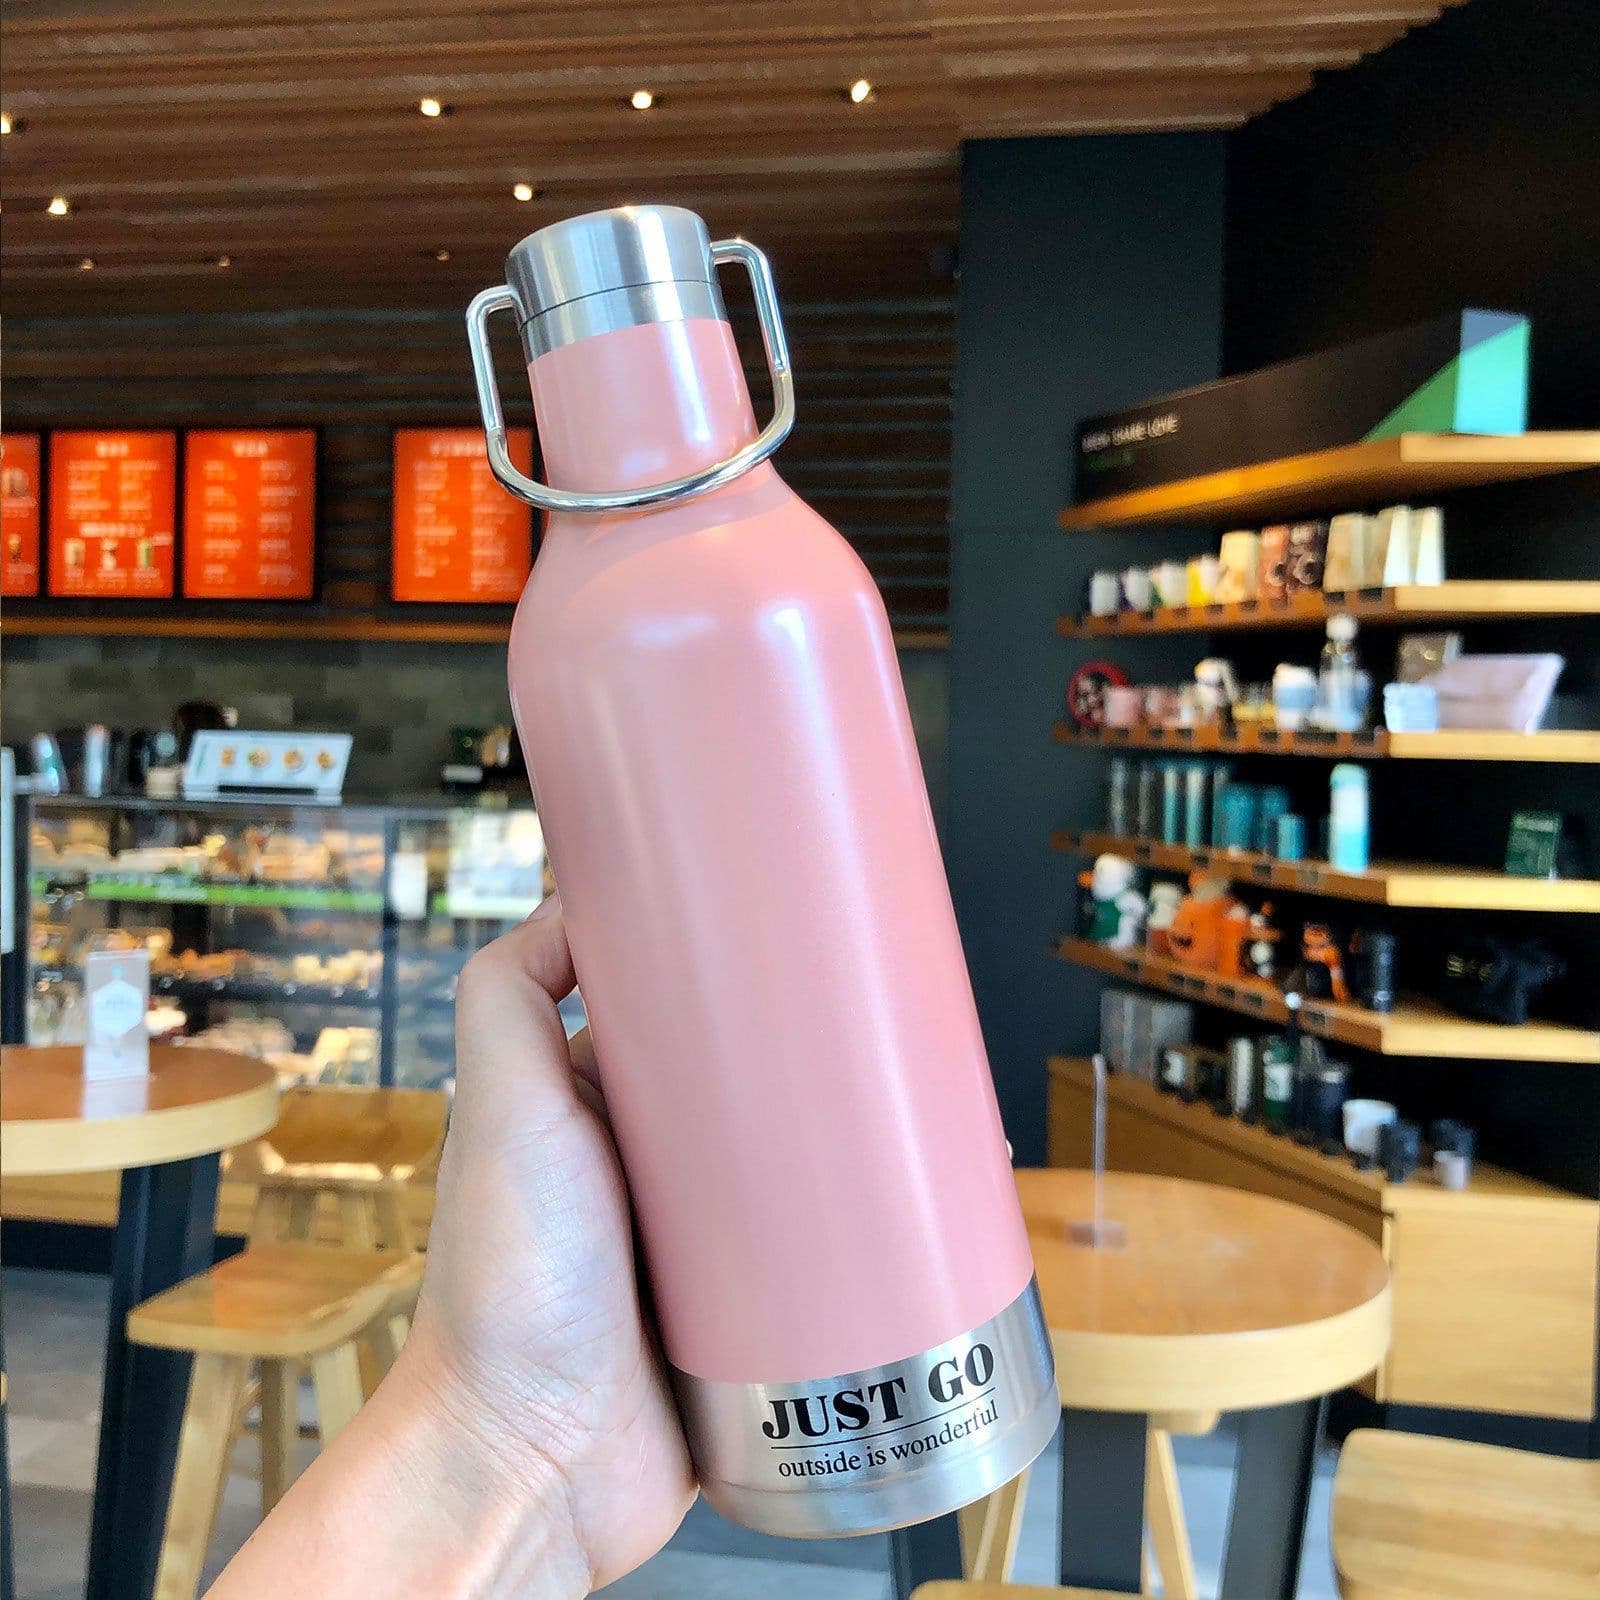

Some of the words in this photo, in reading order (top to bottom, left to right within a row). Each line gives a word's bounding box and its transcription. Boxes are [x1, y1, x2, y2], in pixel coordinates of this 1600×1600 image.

[762, 1376, 907, 1440] JUST
[927, 1342, 995, 1404] GO
[778, 1452, 862, 1477] outside
[866, 1445, 888, 1467] is
[889, 1399, 1000, 1459] wonderful
